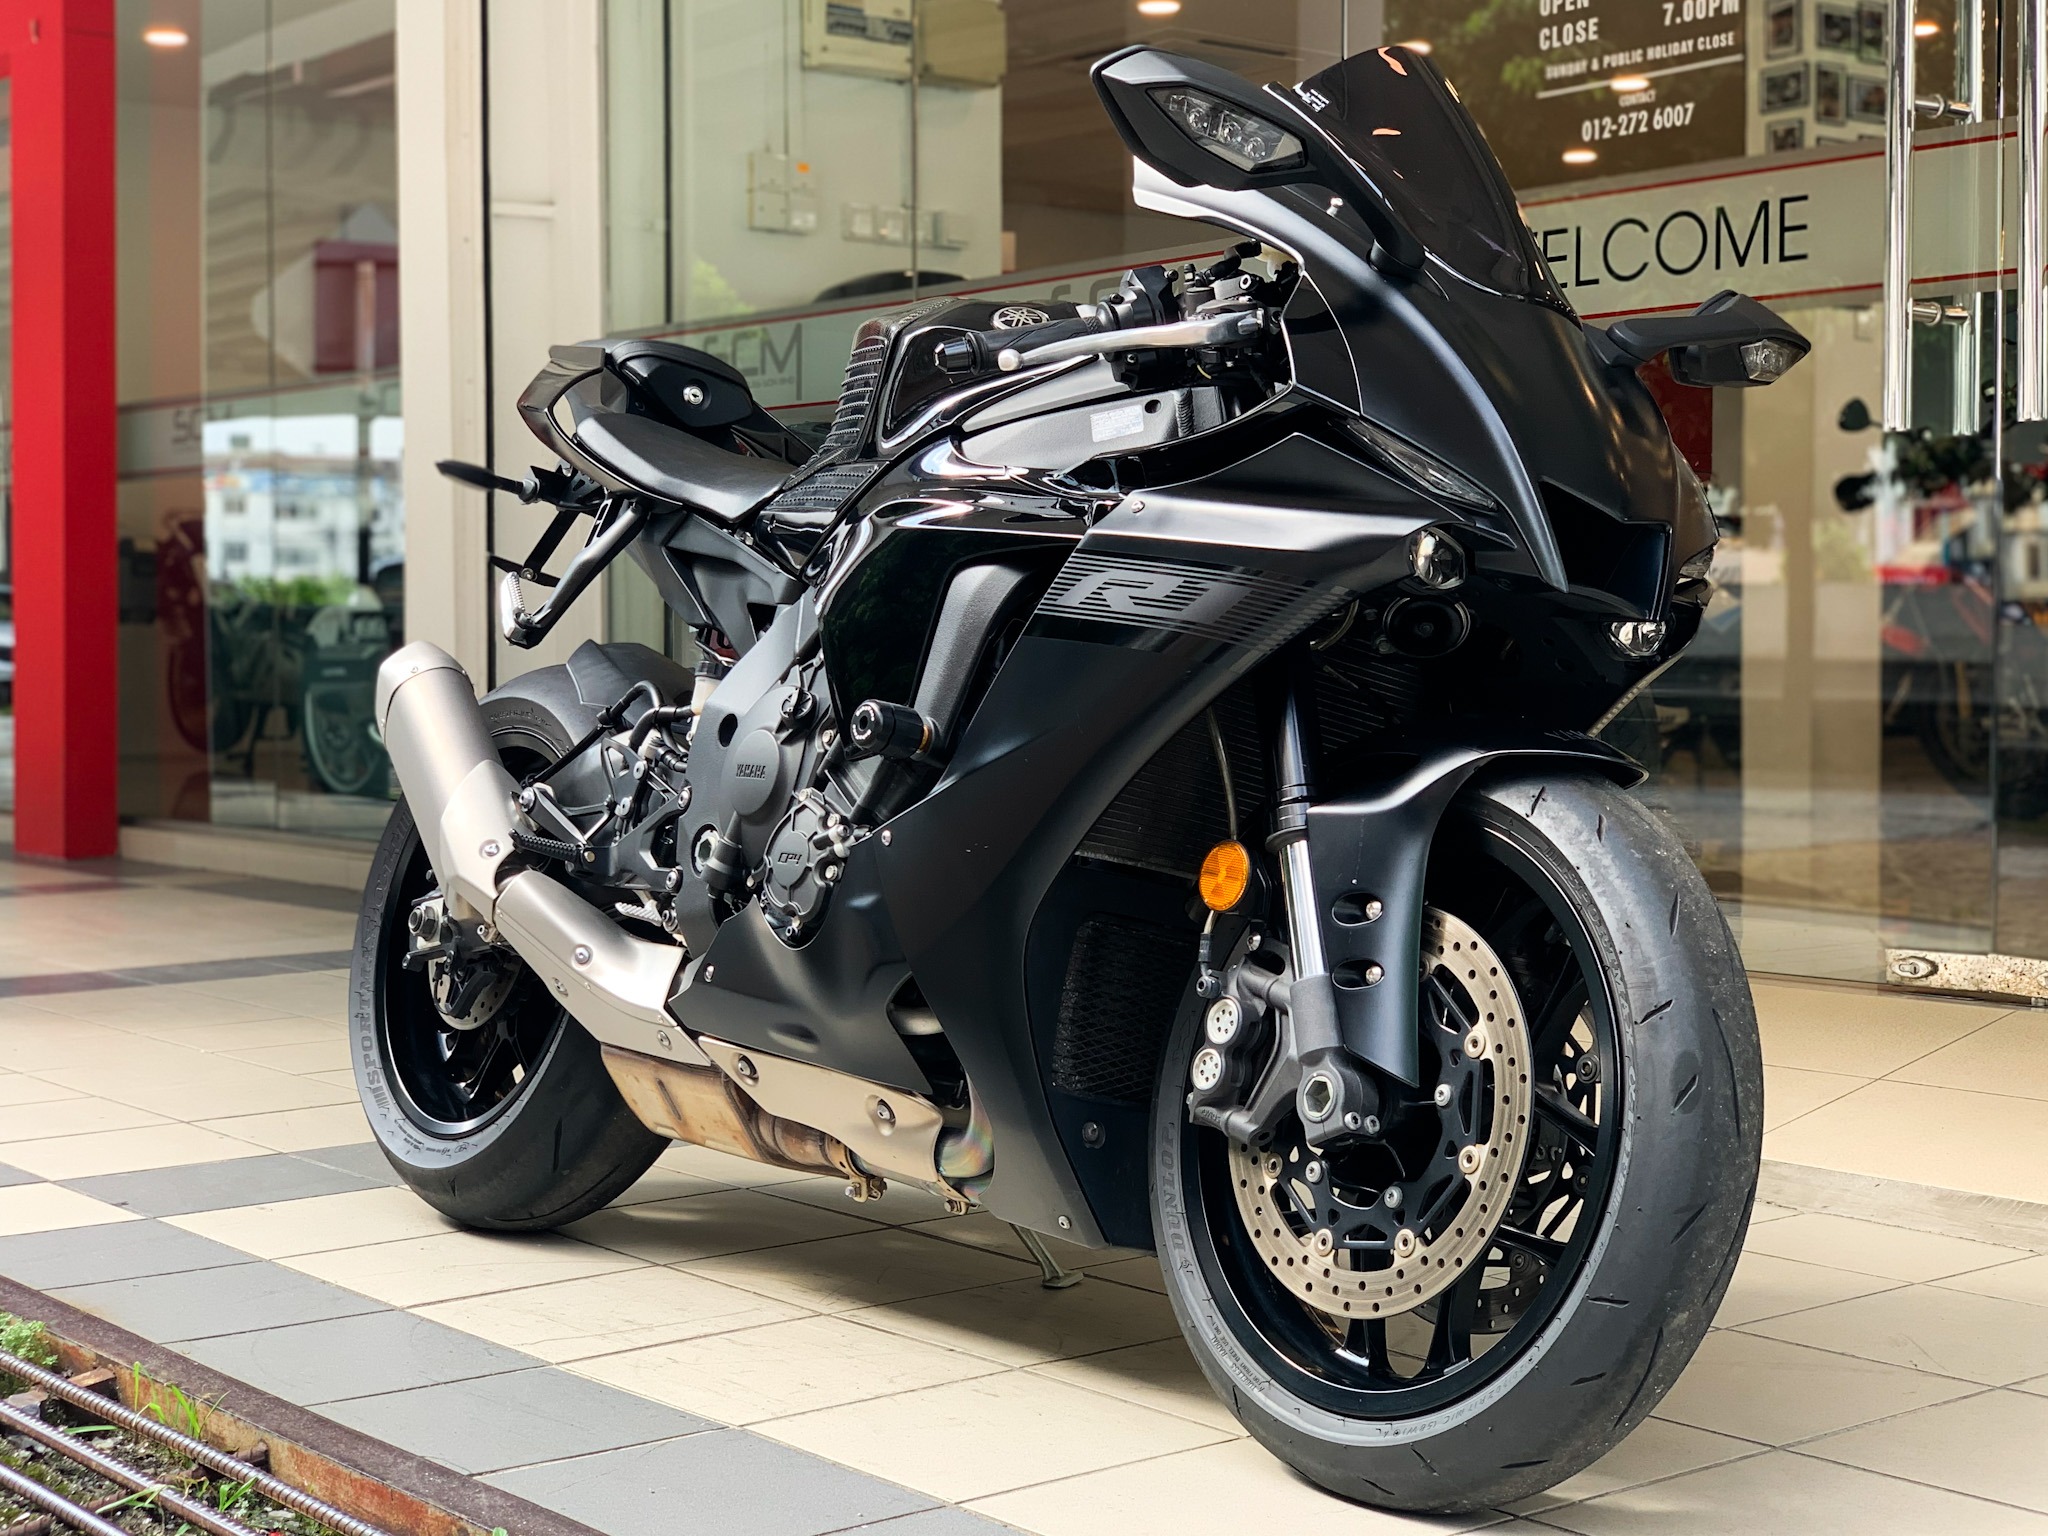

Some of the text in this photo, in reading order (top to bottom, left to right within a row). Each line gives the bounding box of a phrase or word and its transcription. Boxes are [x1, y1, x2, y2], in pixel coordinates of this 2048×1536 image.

[1539, 0, 1740, 50] CLOSE 7.00PM
[1545, 31, 1735, 80] SUNDAY & PUBLIC HOLIDAY CLOSE
[1581, 102, 1695, 142] 012-272 6007
[1618, 89, 1656, 107] CONTACT
[1533, 194, 1809, 290] ELCOME
[1056, 570, 1254, 625] R1
[736, 764, 766, 780] YAMAHA
[778, 852, 802, 865] CP4
[1160, 1127, 1186, 1251] DUNLOP
[1211, 1336, 1258, 1392] TUBELESS RADIAL
